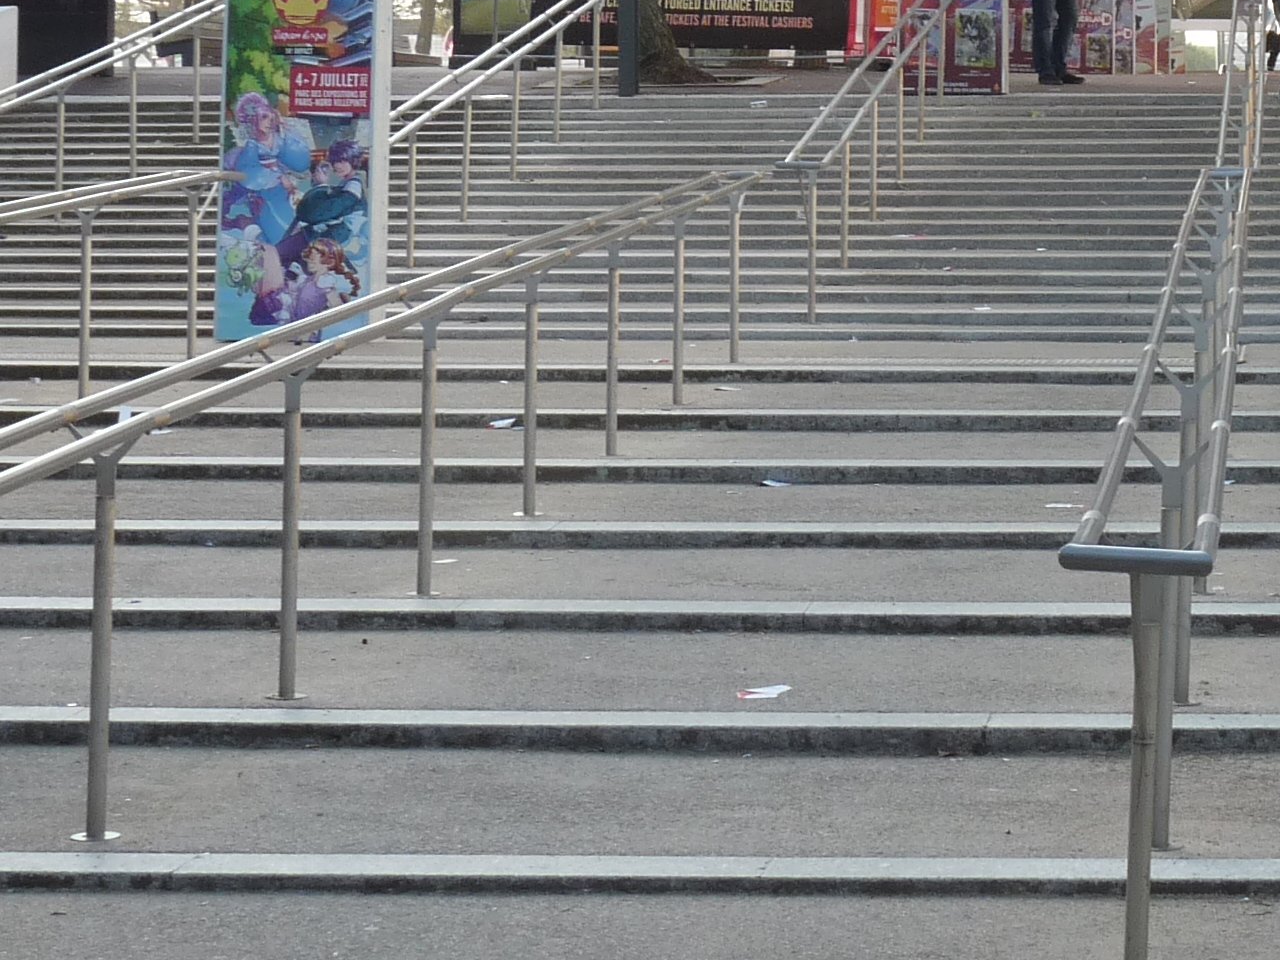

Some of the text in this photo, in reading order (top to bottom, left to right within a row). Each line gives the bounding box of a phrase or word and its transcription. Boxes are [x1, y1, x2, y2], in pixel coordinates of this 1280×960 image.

[754, 0, 794, 13] TICKETS!
[664, 13, 813, 28] TICKETS AT THE FESTIVAL CASHIERS
[273, 29, 327, 41] Japan Expo
[319, 73, 358, 87] JUILLET
